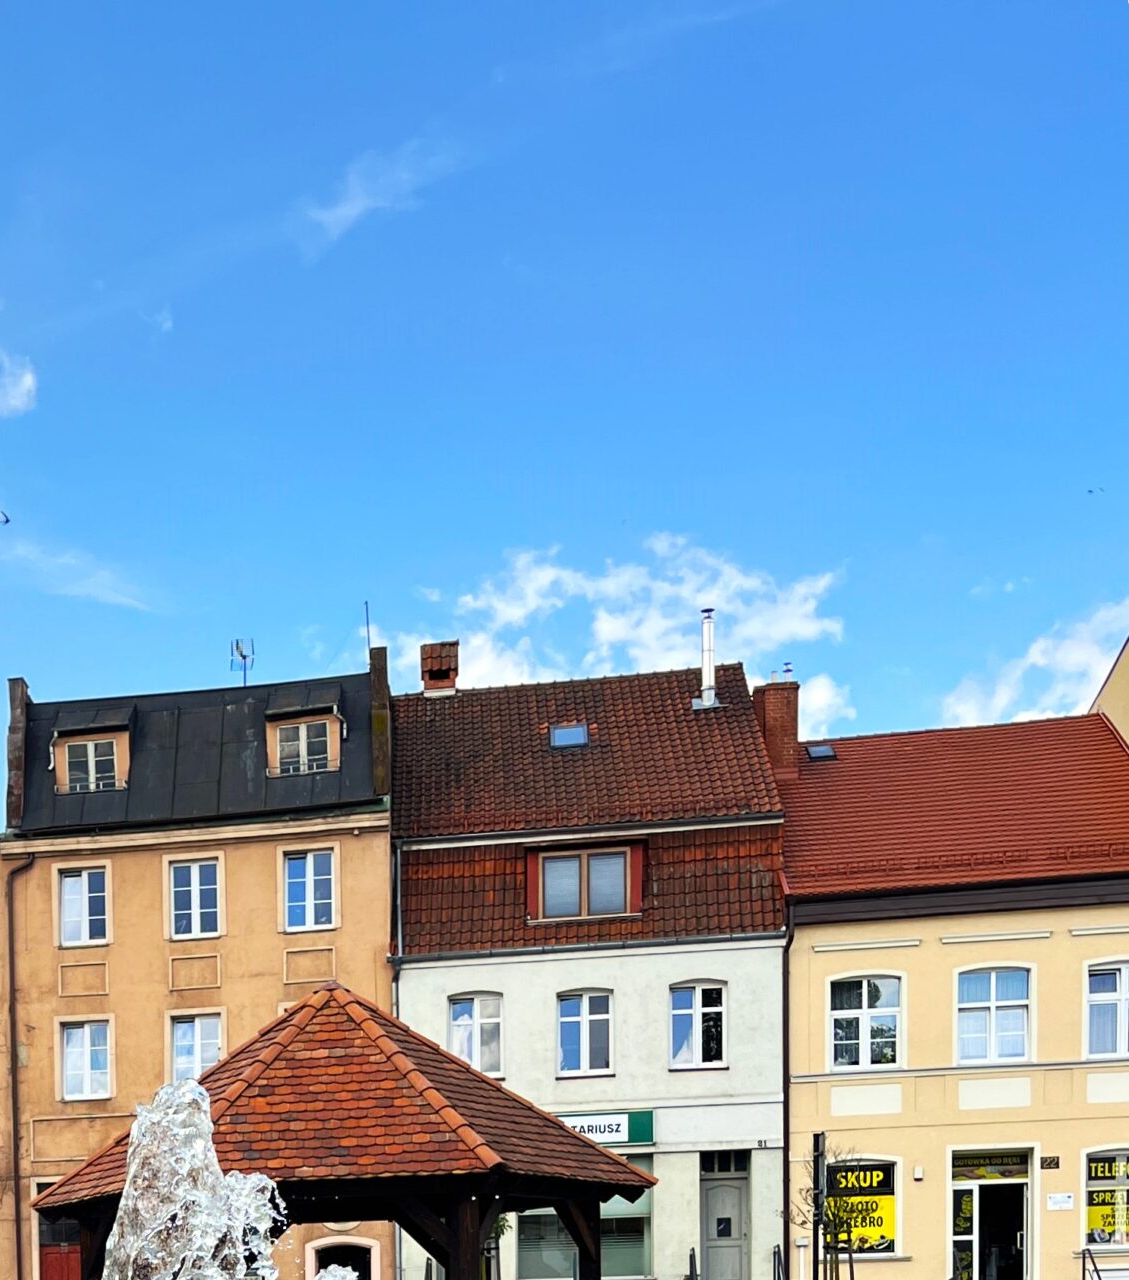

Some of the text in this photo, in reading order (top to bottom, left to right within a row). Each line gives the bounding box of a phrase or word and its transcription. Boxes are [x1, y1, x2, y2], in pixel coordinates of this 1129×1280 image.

[1042, 1157, 1058, 1169] 22
[836, 1170, 884, 1188] SKUP
[839, 1216, 884, 1229] REBRO
